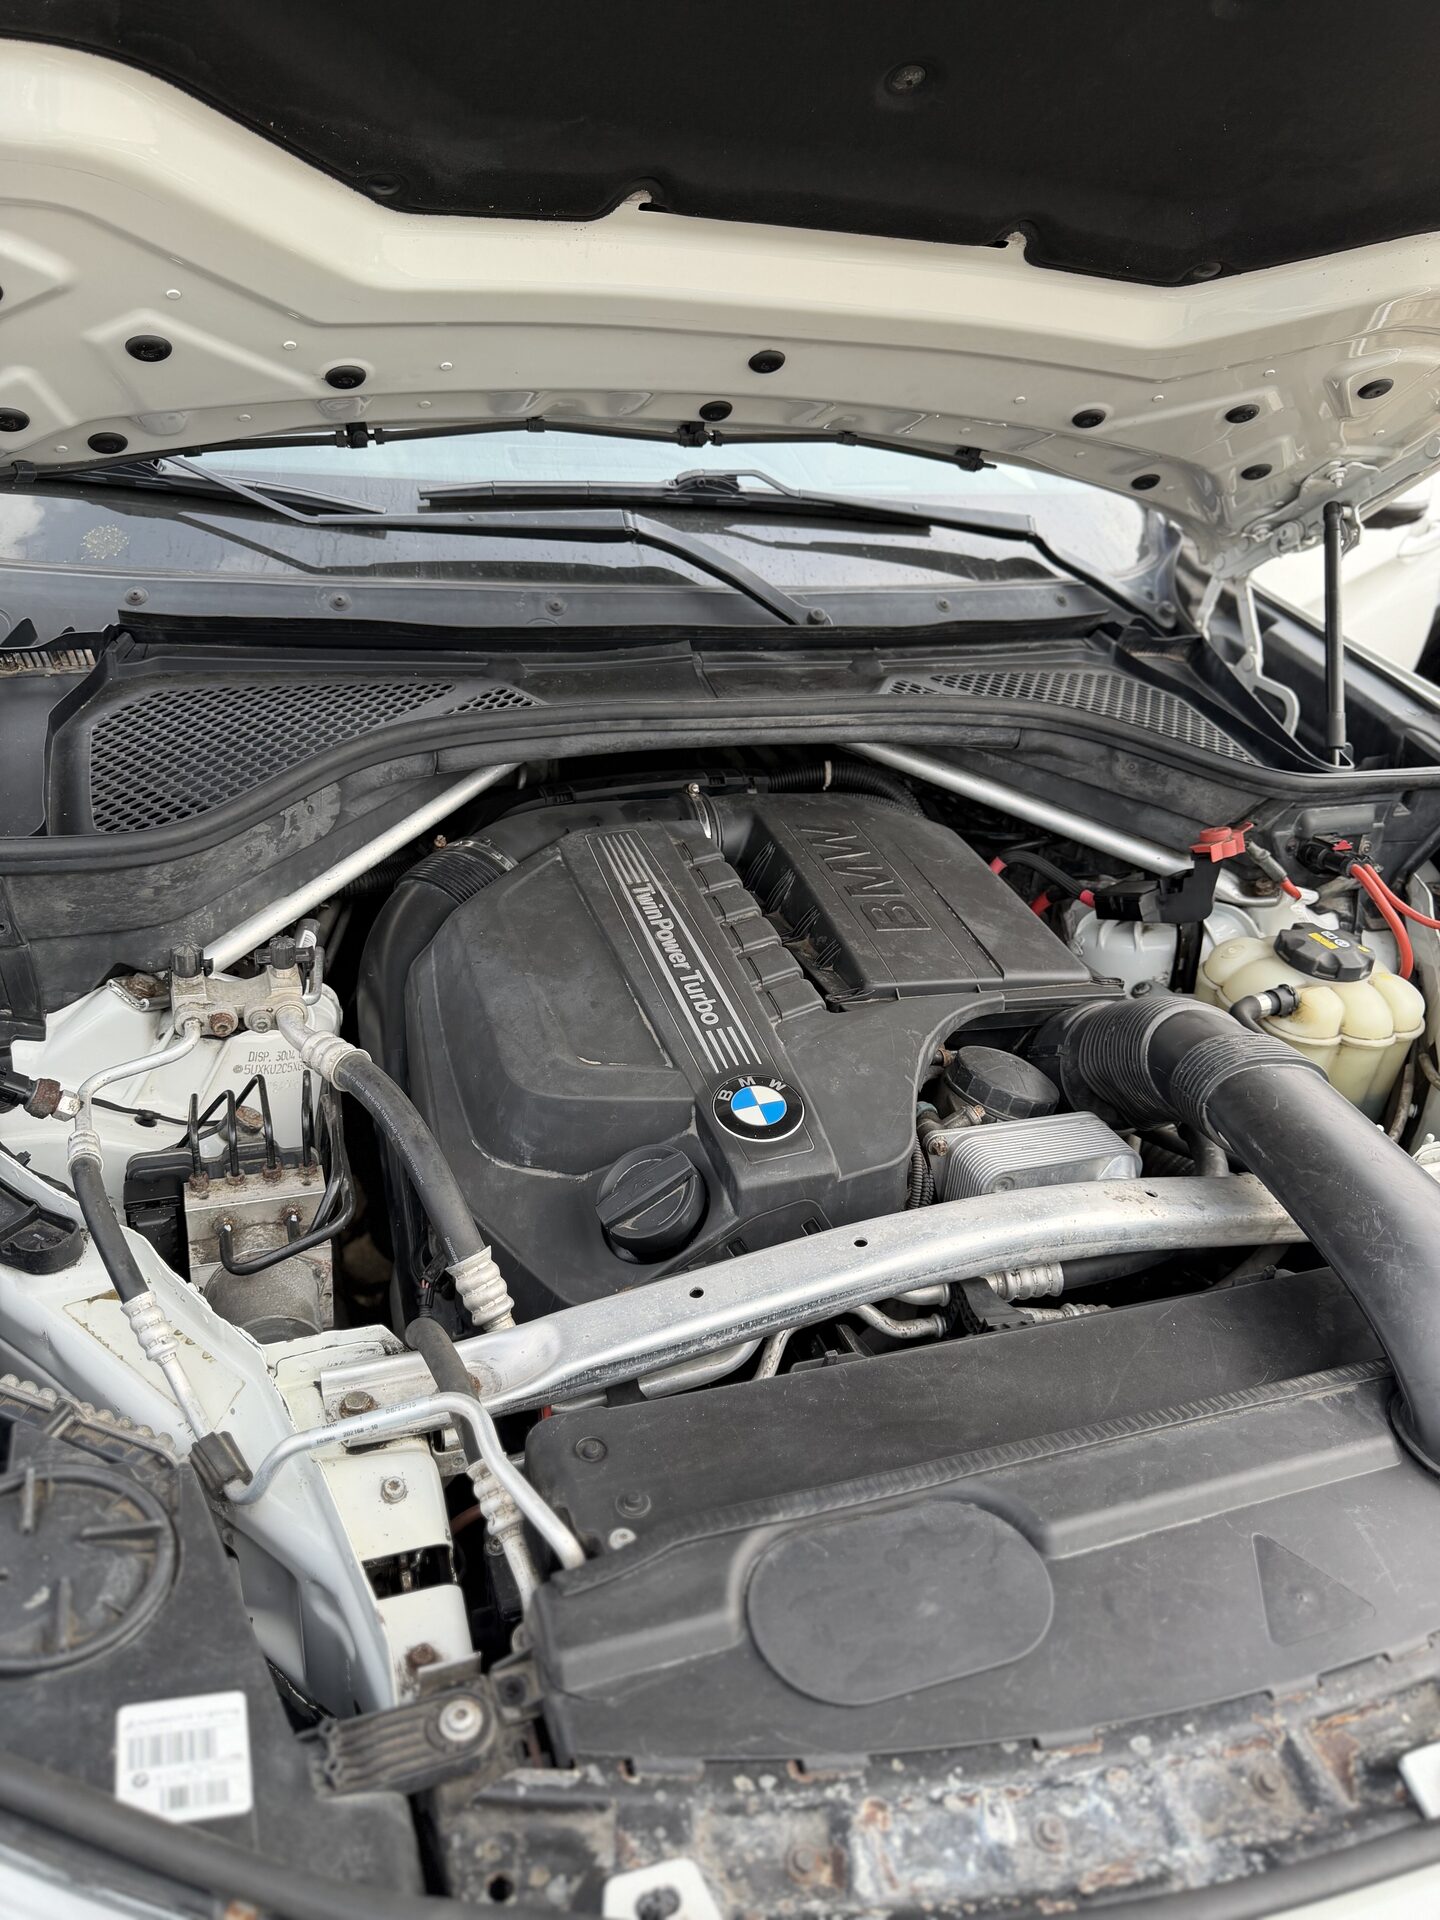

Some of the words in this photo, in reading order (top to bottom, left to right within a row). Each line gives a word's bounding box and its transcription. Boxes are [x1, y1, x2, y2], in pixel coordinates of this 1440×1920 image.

[796, 825, 932, 931] BMW
[631, 882, 692, 971] TwinPower
[679, 969, 720, 1026] Turbo
[248, 1051, 271, 1062] DISP.
[717, 1076, 787, 1102] BMW
